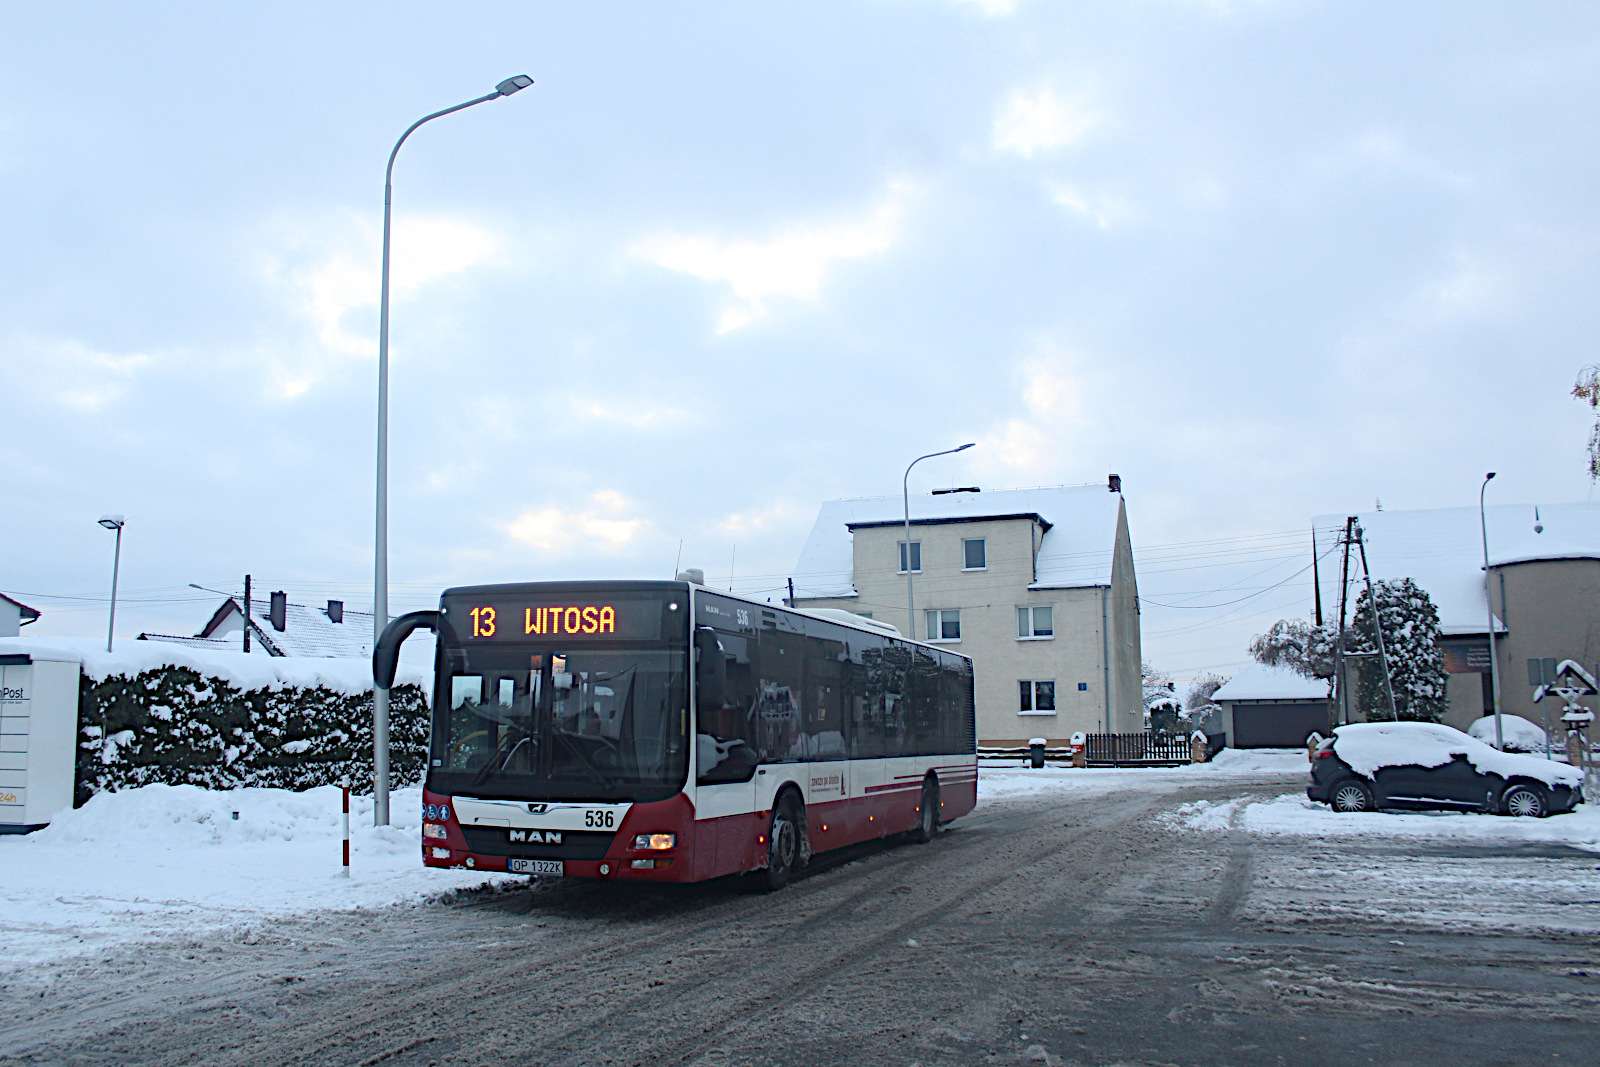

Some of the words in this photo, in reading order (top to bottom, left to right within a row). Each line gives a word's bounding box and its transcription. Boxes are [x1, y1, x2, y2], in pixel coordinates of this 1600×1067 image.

[705, 604, 719, 615] MAN
[736, 608, 749, 626] 536
[469, 606, 496, 637] 13
[524, 605, 615, 635] WITOSA
[585, 810, 614, 828] 536
[509, 829, 562, 844] MAN
[513, 860, 528, 872] OP
[531, 860, 561, 874] 1322K
